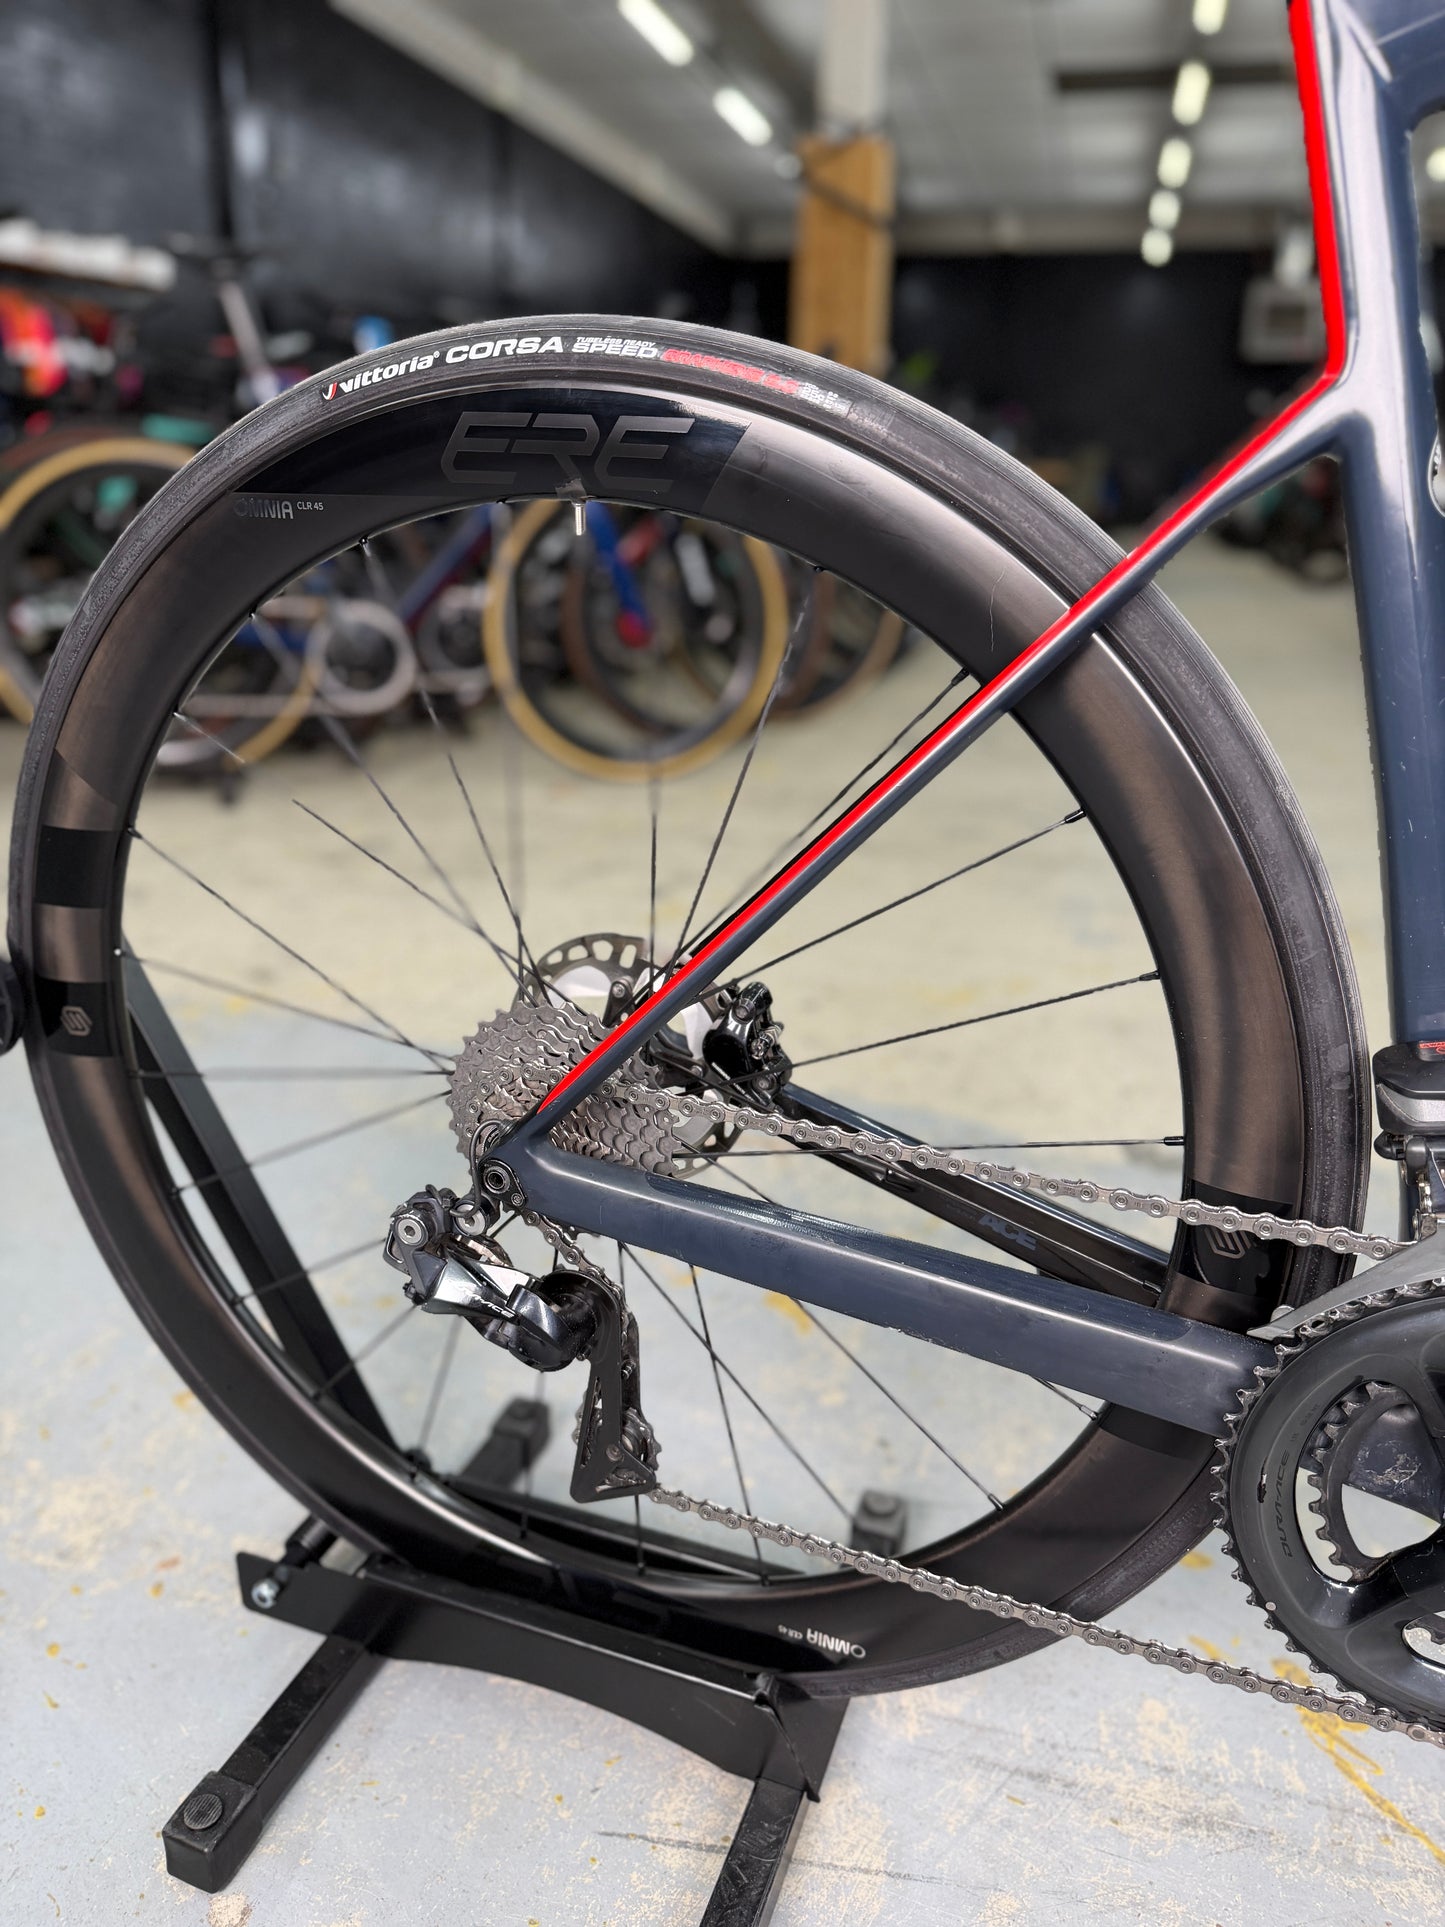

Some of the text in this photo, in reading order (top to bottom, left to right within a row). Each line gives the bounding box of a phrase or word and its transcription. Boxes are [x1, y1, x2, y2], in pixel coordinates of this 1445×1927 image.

[445, 336, 563, 364] CORSA
[572, 343, 658, 358] SPEED
[623, 339, 656, 348] READY
[441, 411, 696, 492] ERE
[233, 498, 324, 519] OMNIA CLR 45
[1273, 1450, 1293, 1558] DURA-ACE
[806, 1627, 866, 1659] OMNIA
